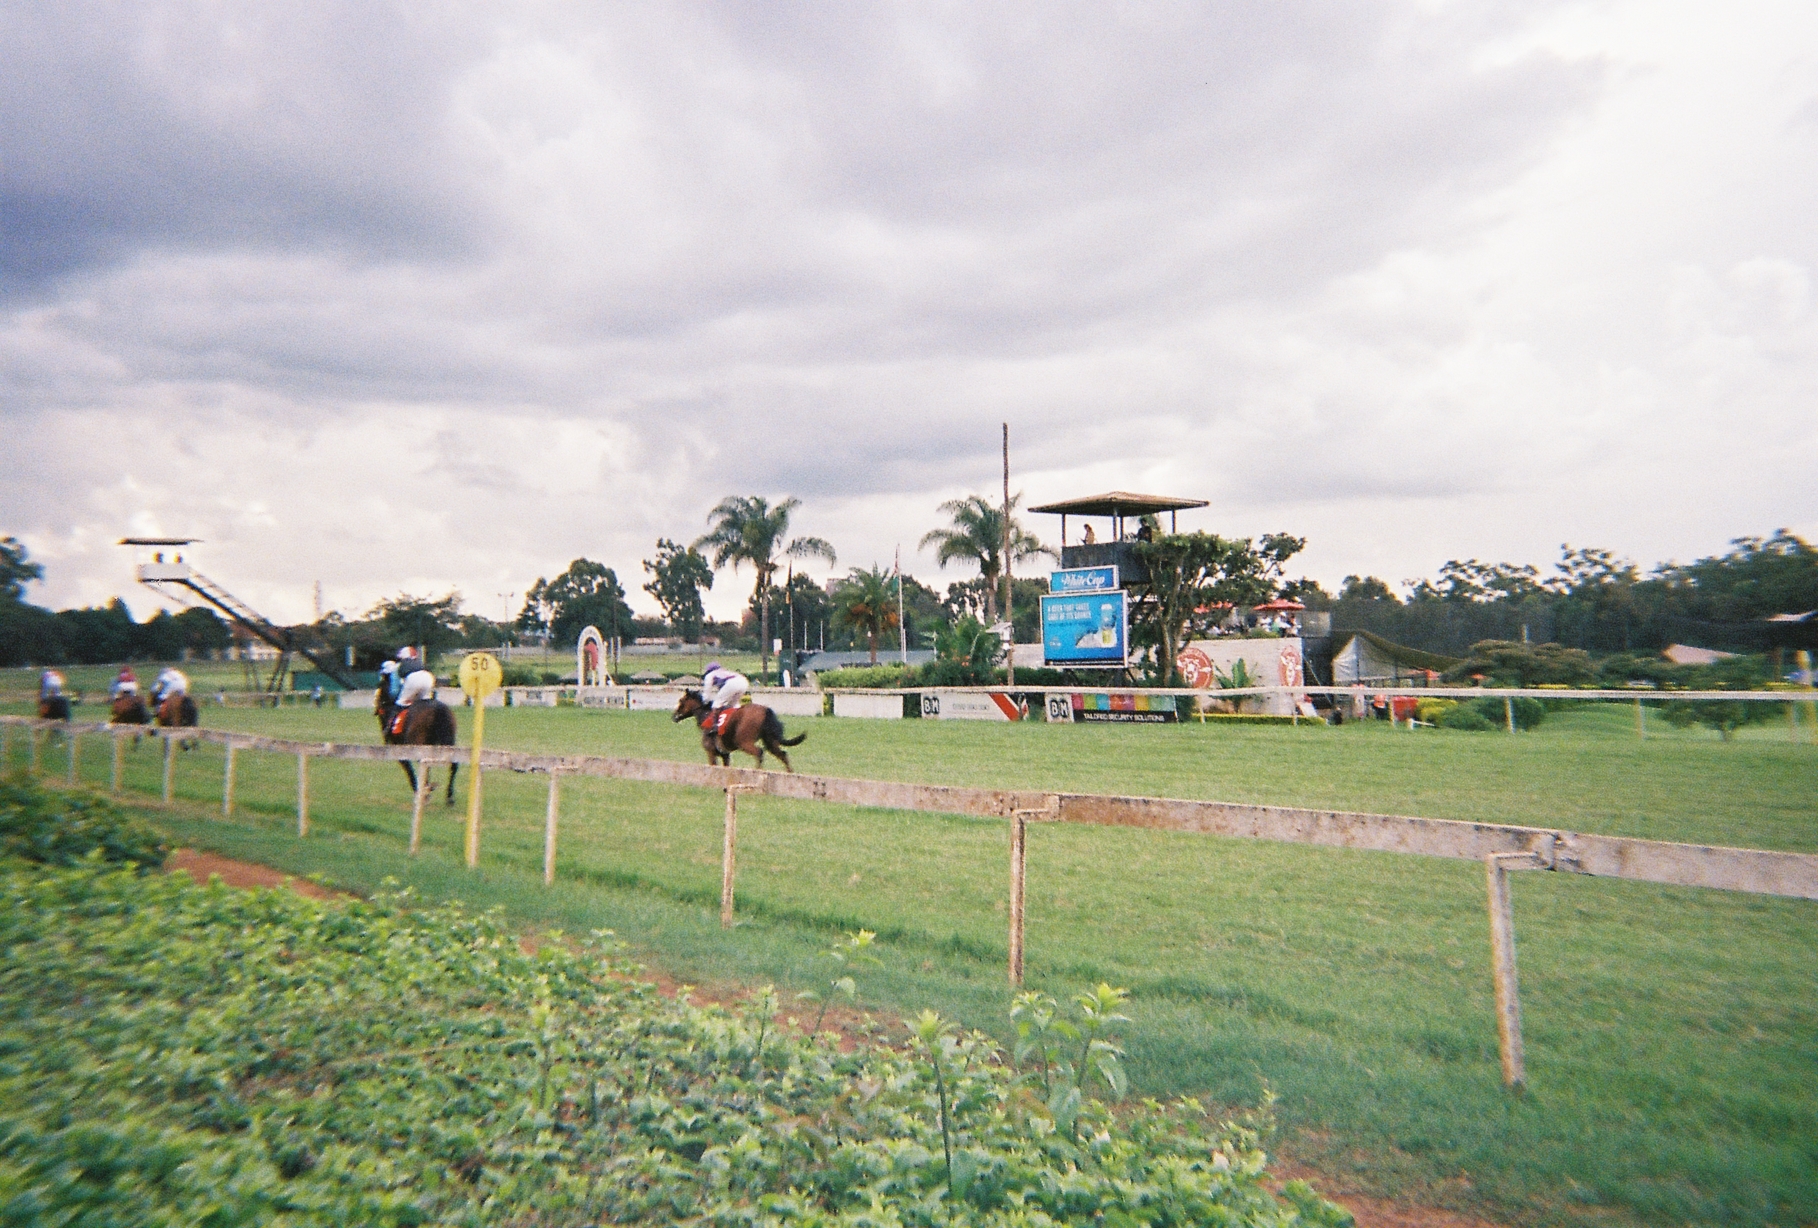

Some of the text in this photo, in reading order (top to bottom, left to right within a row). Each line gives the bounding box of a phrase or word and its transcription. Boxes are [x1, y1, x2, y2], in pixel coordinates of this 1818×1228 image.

[1061, 571, 1105, 589] White Cap
[471, 657, 488, 670] 50
[717, 713, 727, 727] 3
